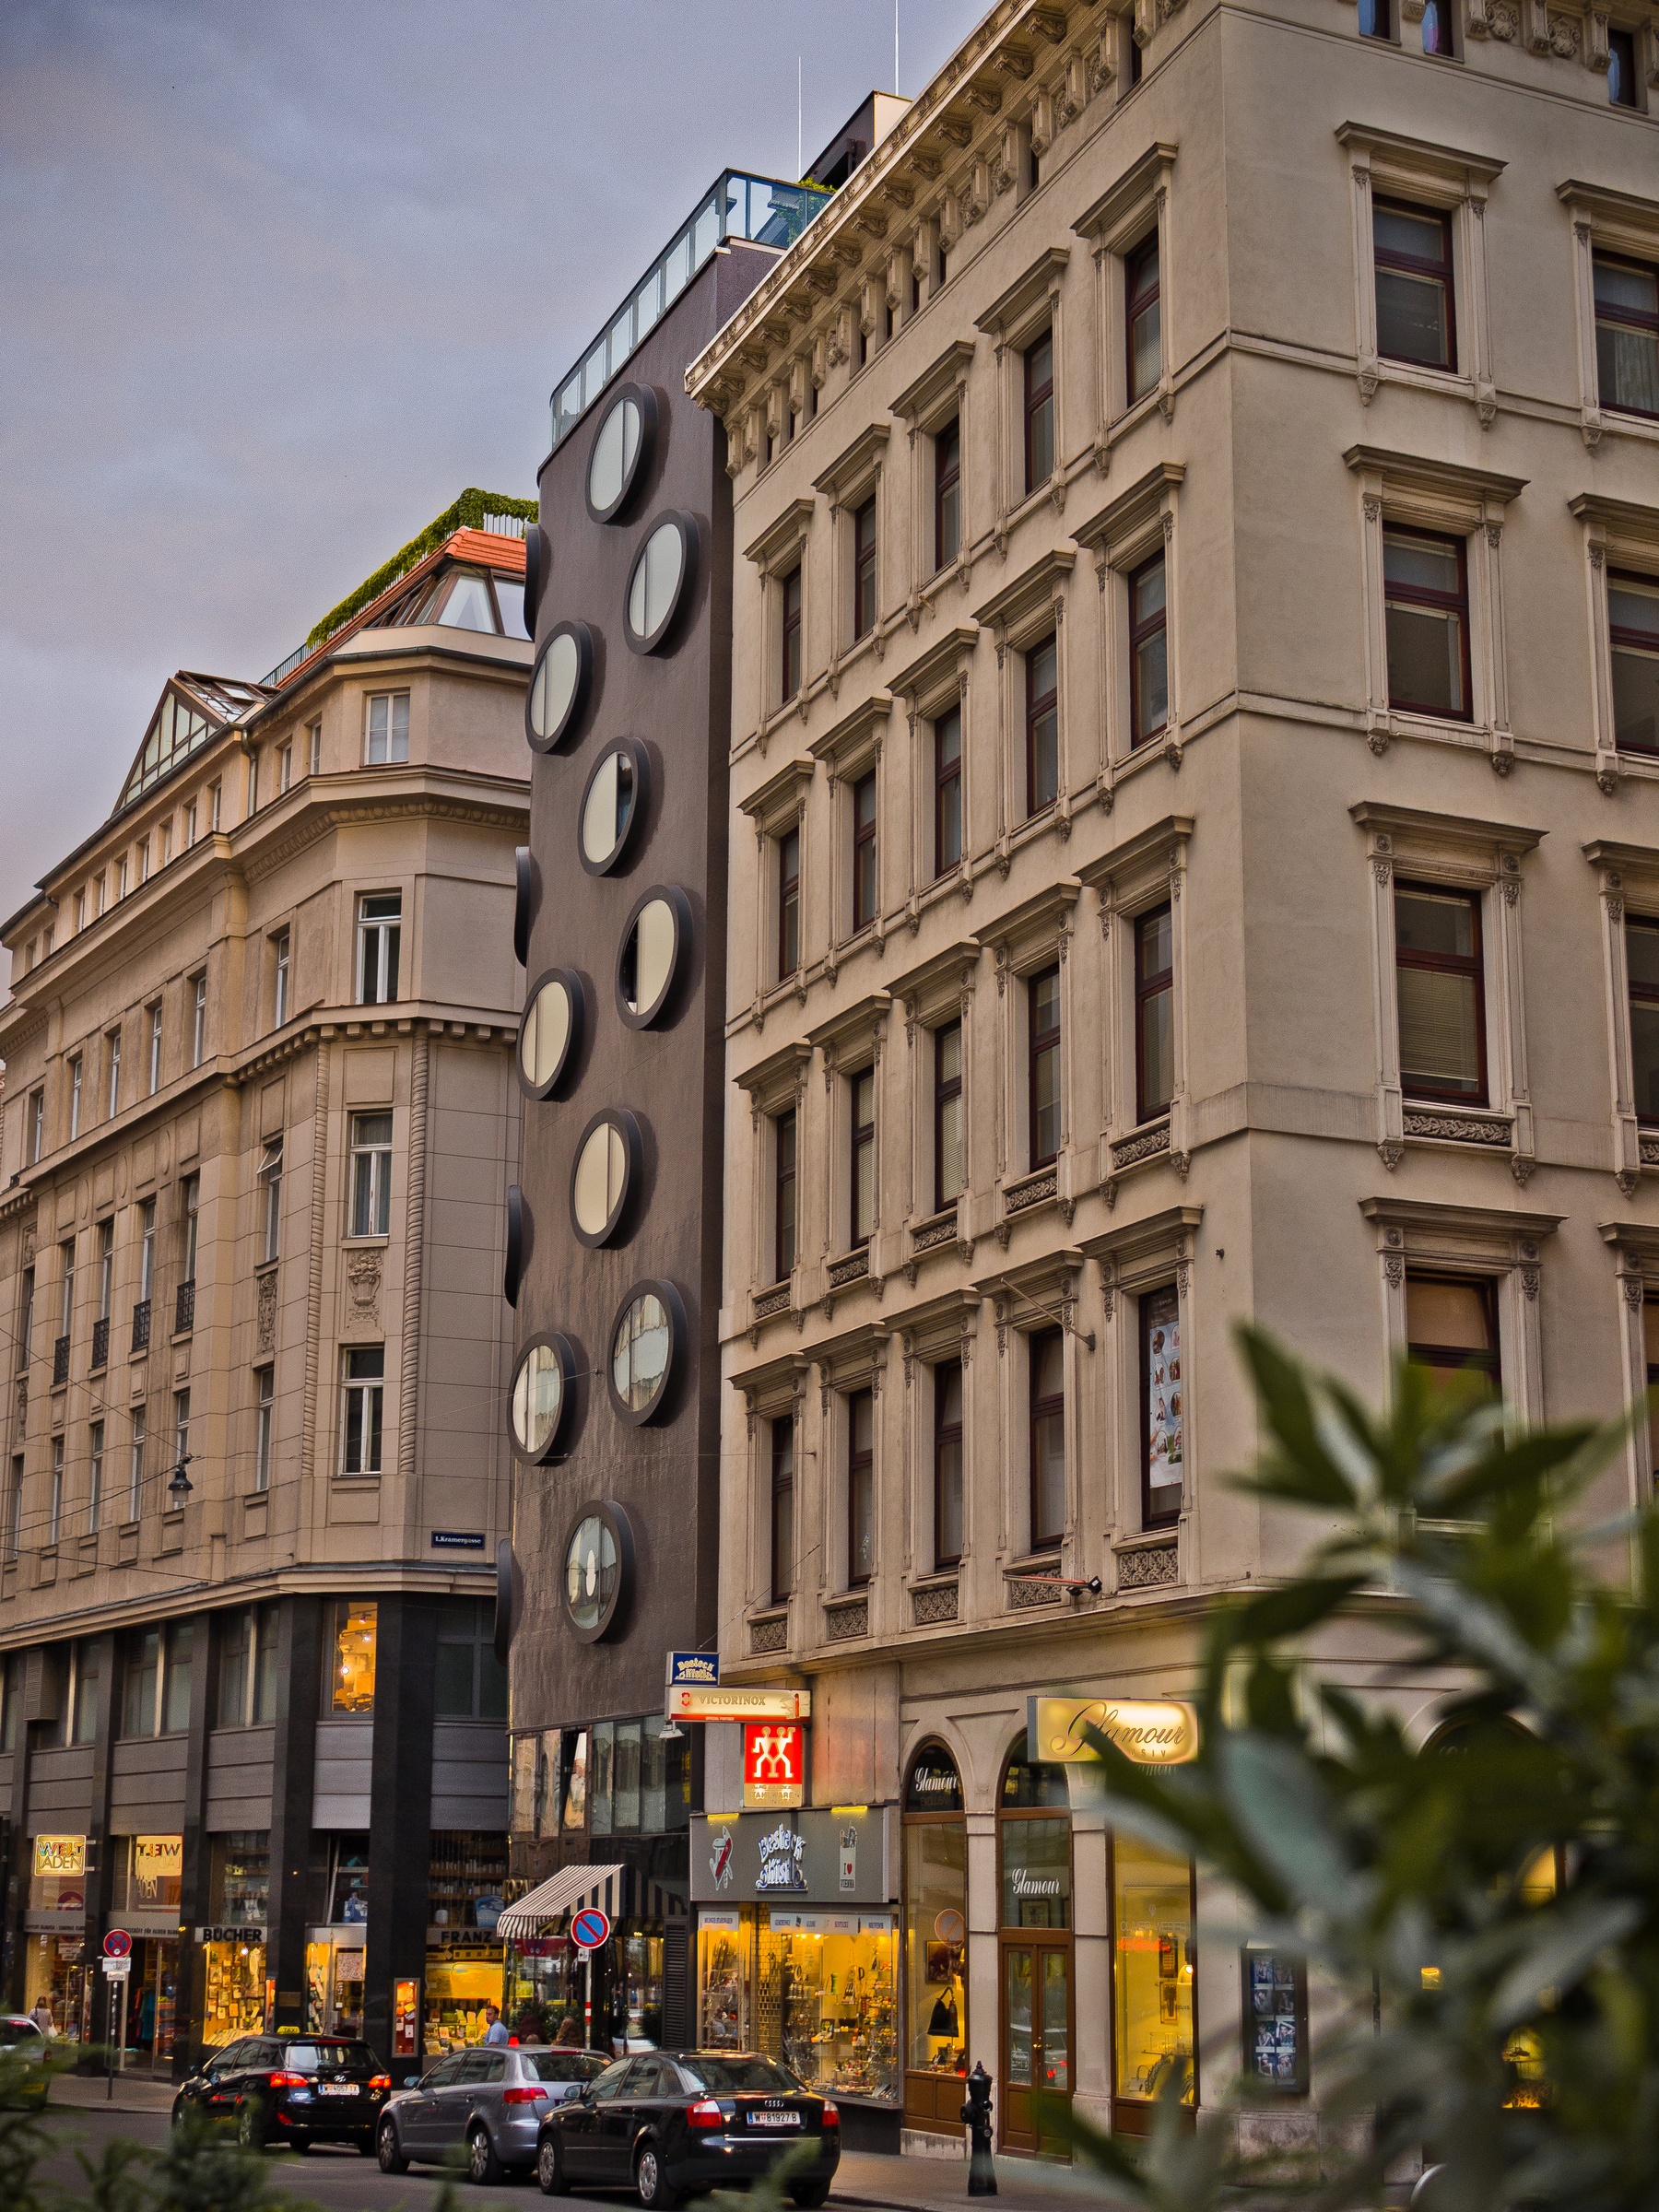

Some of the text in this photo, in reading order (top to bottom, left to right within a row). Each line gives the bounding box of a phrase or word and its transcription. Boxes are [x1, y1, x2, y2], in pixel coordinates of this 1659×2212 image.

[677, 1658, 715, 1672] Besteck
[698, 1694, 766, 1706] VICTORINOX
[1050, 1700, 1185, 1758] Glamour
[1084, 1746, 1168, 1758] EUSIV
[914, 1766, 958, 1792] Glamour
[37, 1841, 84, 1857] WELT
[759, 1822, 806, 1863] Besteck
[37, 1854, 83, 1870] LADEN
[1011, 1867, 1061, 1894] Glamour
[203, 1926, 262, 1942] BÜCHER
[441, 1931, 492, 1943] FRANZ
[767, 2112, 790, 2123] 81927
